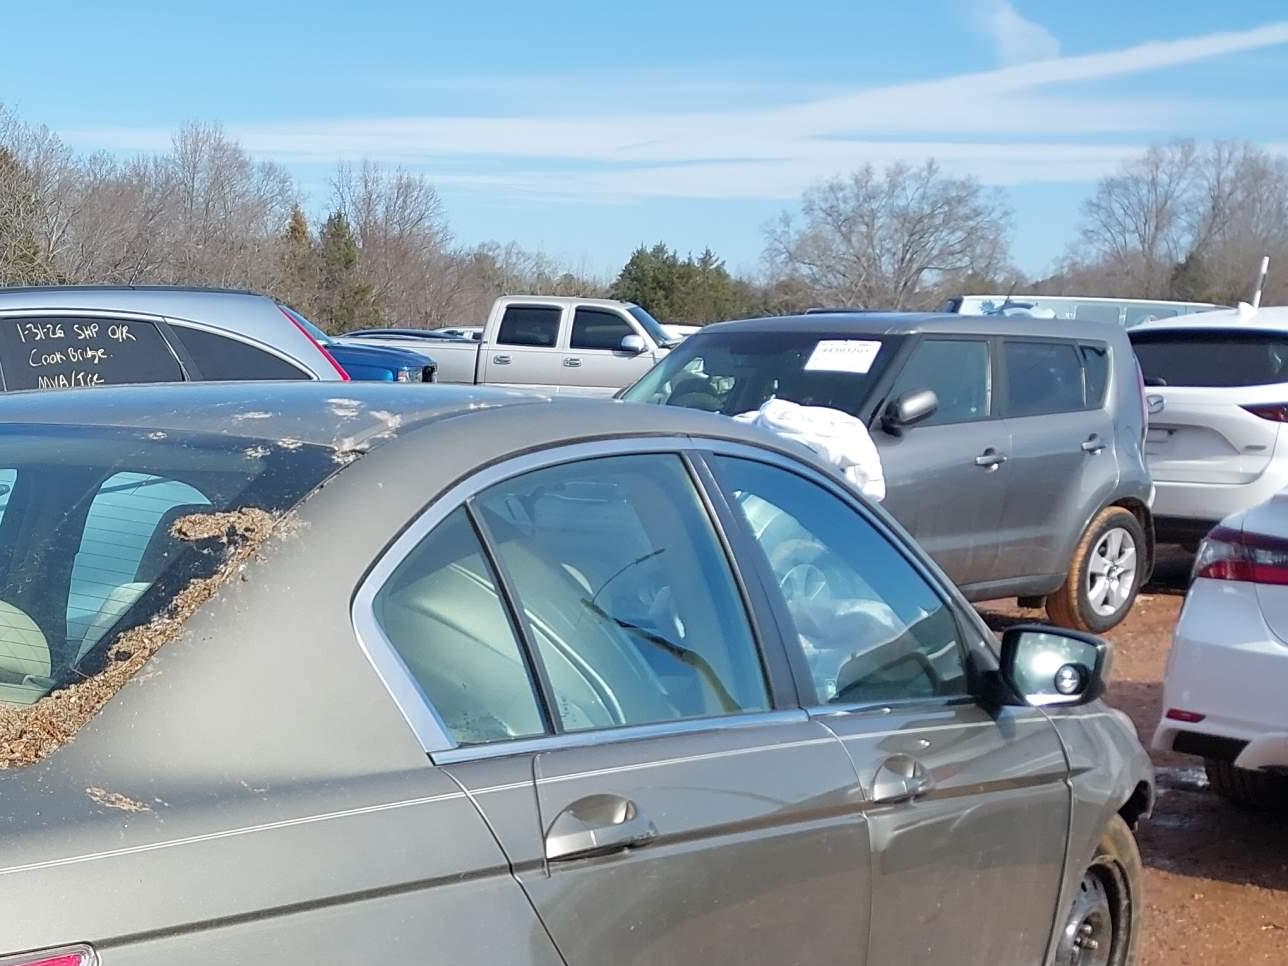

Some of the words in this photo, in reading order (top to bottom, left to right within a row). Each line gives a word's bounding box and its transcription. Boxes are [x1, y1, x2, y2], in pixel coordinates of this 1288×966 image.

[17, 323, 65, 342] 1-31-26
[73, 323, 99, 340] SHP
[29, 348, 66, 367] Cook
